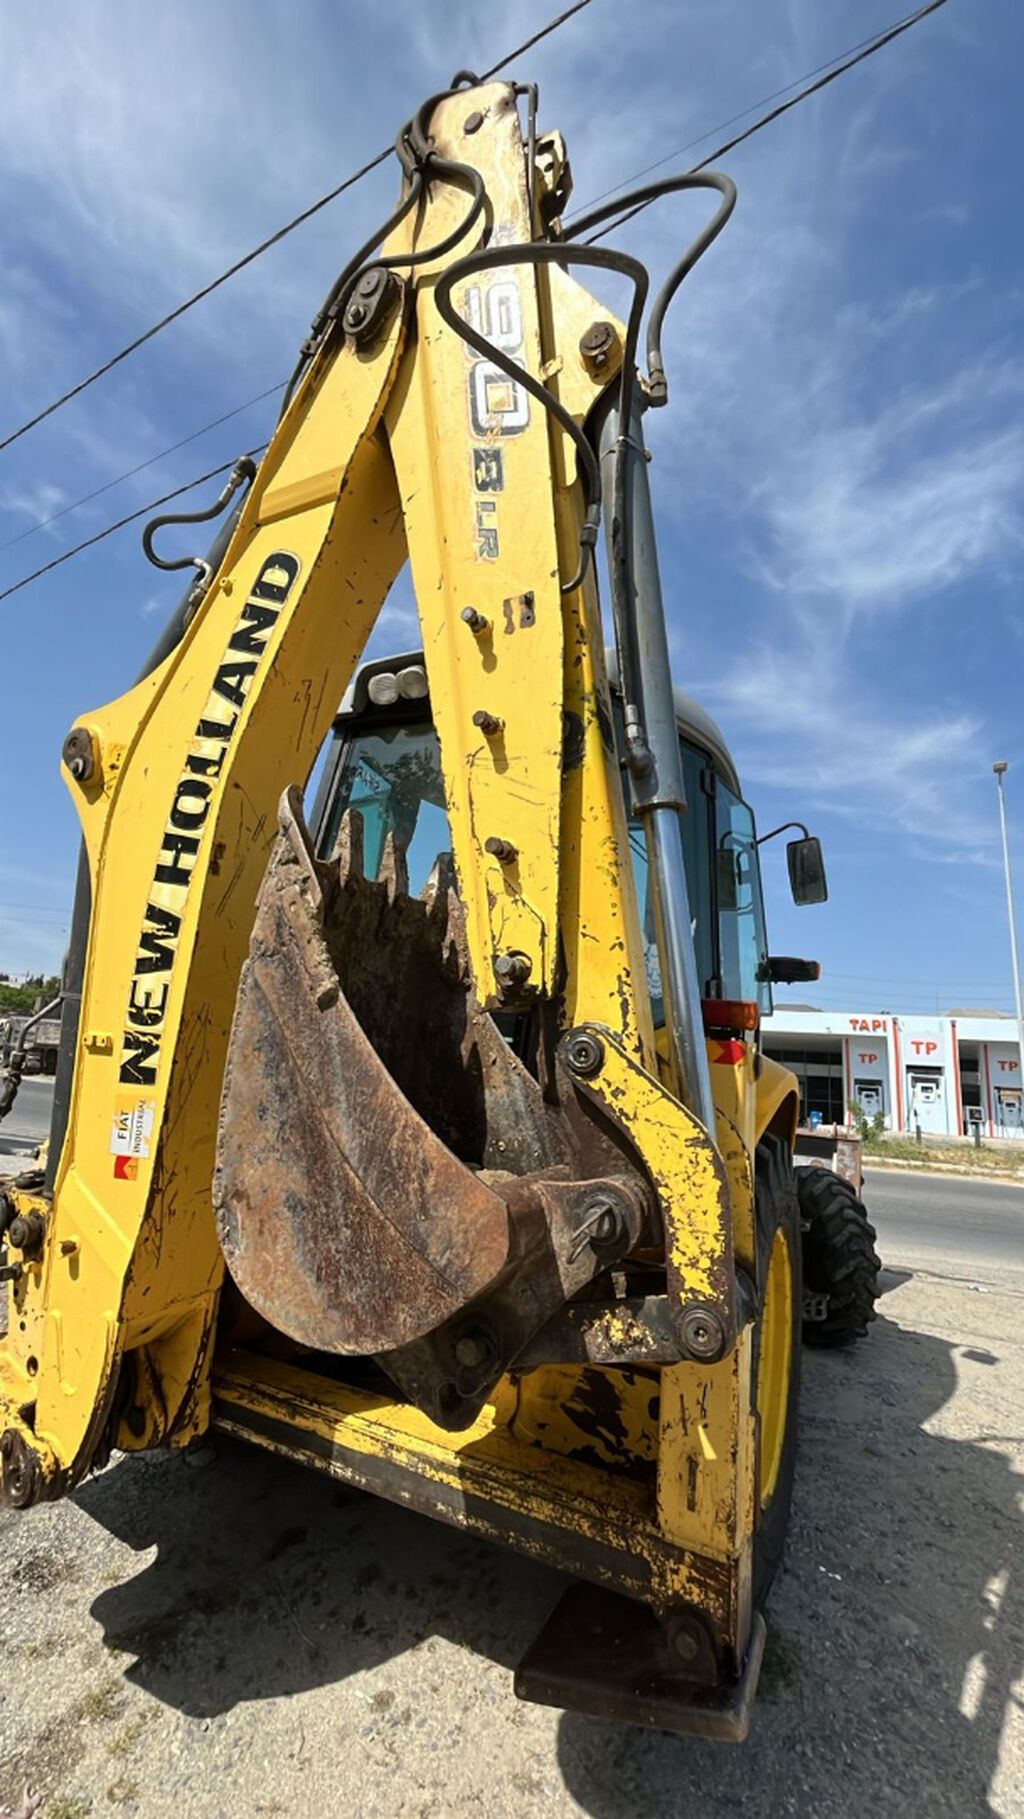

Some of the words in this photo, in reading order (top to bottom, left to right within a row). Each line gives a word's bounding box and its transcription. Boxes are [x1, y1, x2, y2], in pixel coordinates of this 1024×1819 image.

[119, 903, 180, 1085] NEW
[156, 551, 300, 888] HOLLAND
[849, 1018, 887, 1032] TAPI
[911, 1041, 937, 1055] TP
[859, 1054, 877, 1064] TP
[998, 1060, 1019, 1072] TP
[118, 1110, 129, 1140] FIAT
[133, 1099, 147, 1153] INDUSTRIAL
